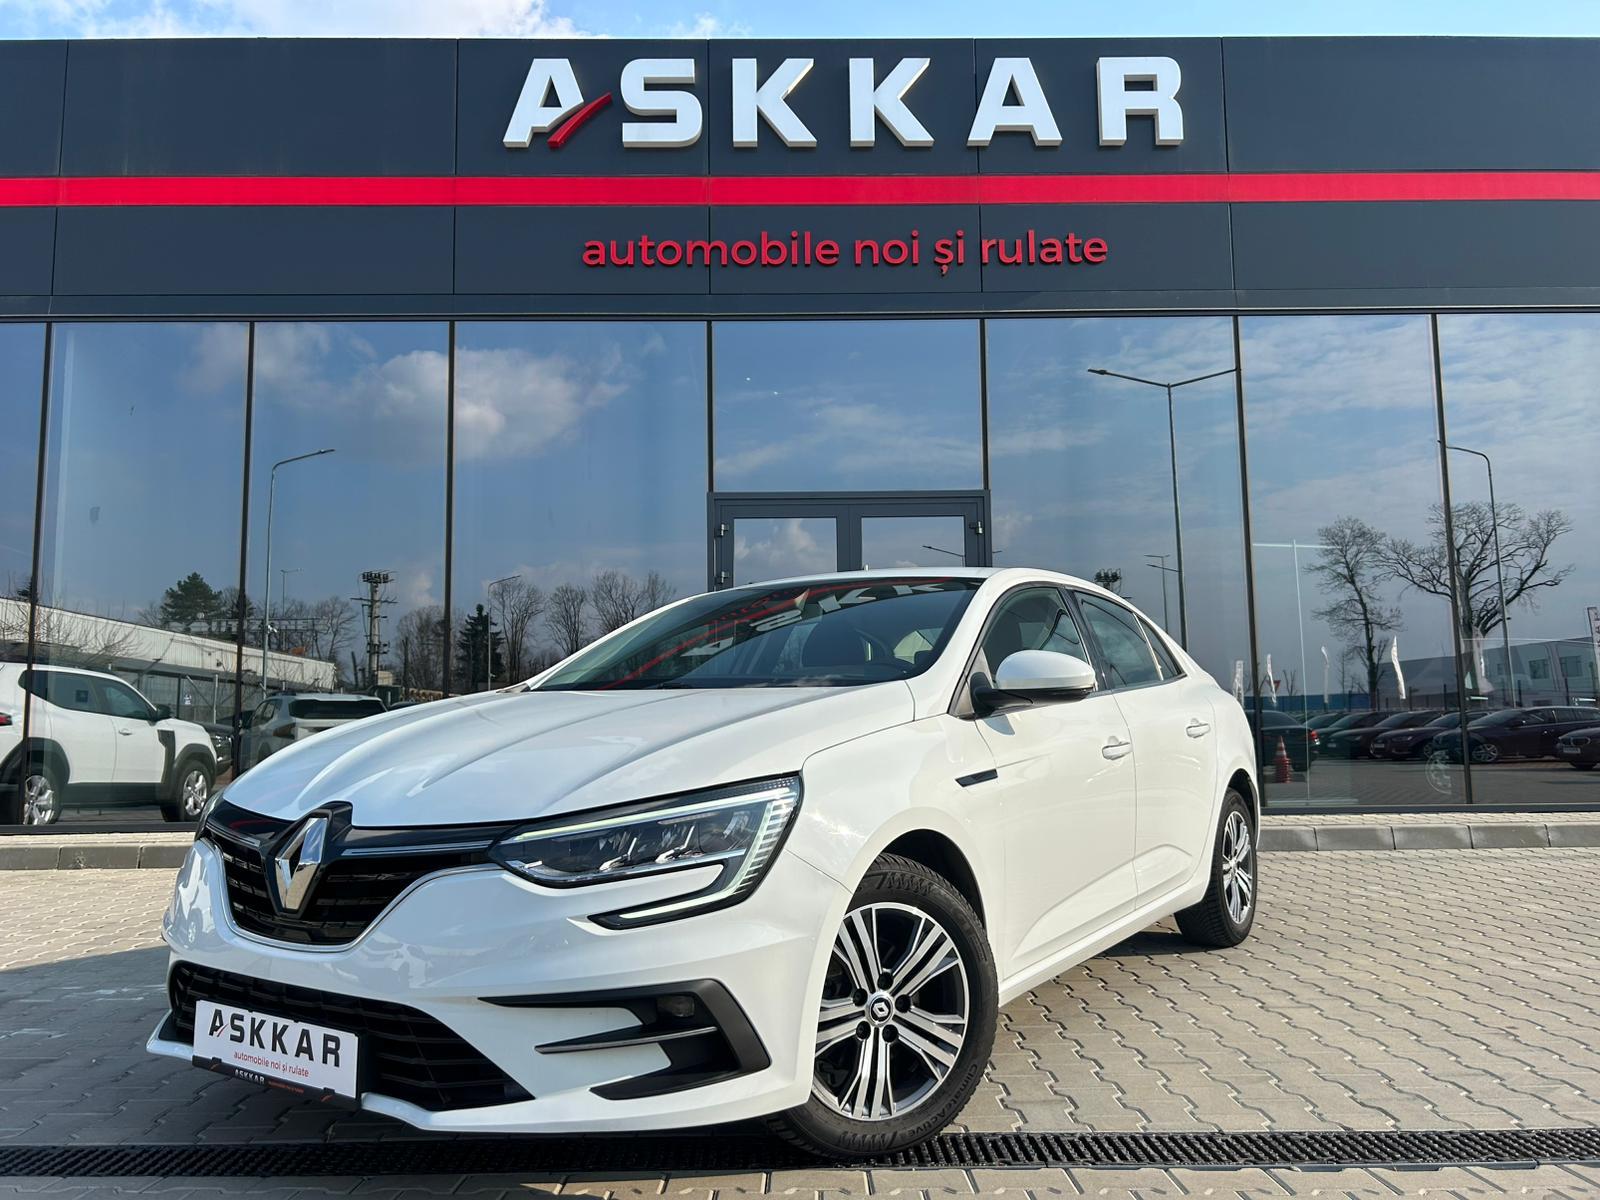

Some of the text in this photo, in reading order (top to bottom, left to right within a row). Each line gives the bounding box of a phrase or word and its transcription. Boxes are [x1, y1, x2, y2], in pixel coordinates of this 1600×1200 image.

[503, 56, 1185, 149] ASKKAR
[581, 230, 841, 269] automobile
[854, 229, 921, 267] noi
[980, 228, 1109, 266] rulate
[209, 1009, 341, 1067] ASKKAR
[233, 1051, 269, 1067] automobile
[271, 1060, 281, 1070] noi
[289, 1065, 309, 1077] rulate
